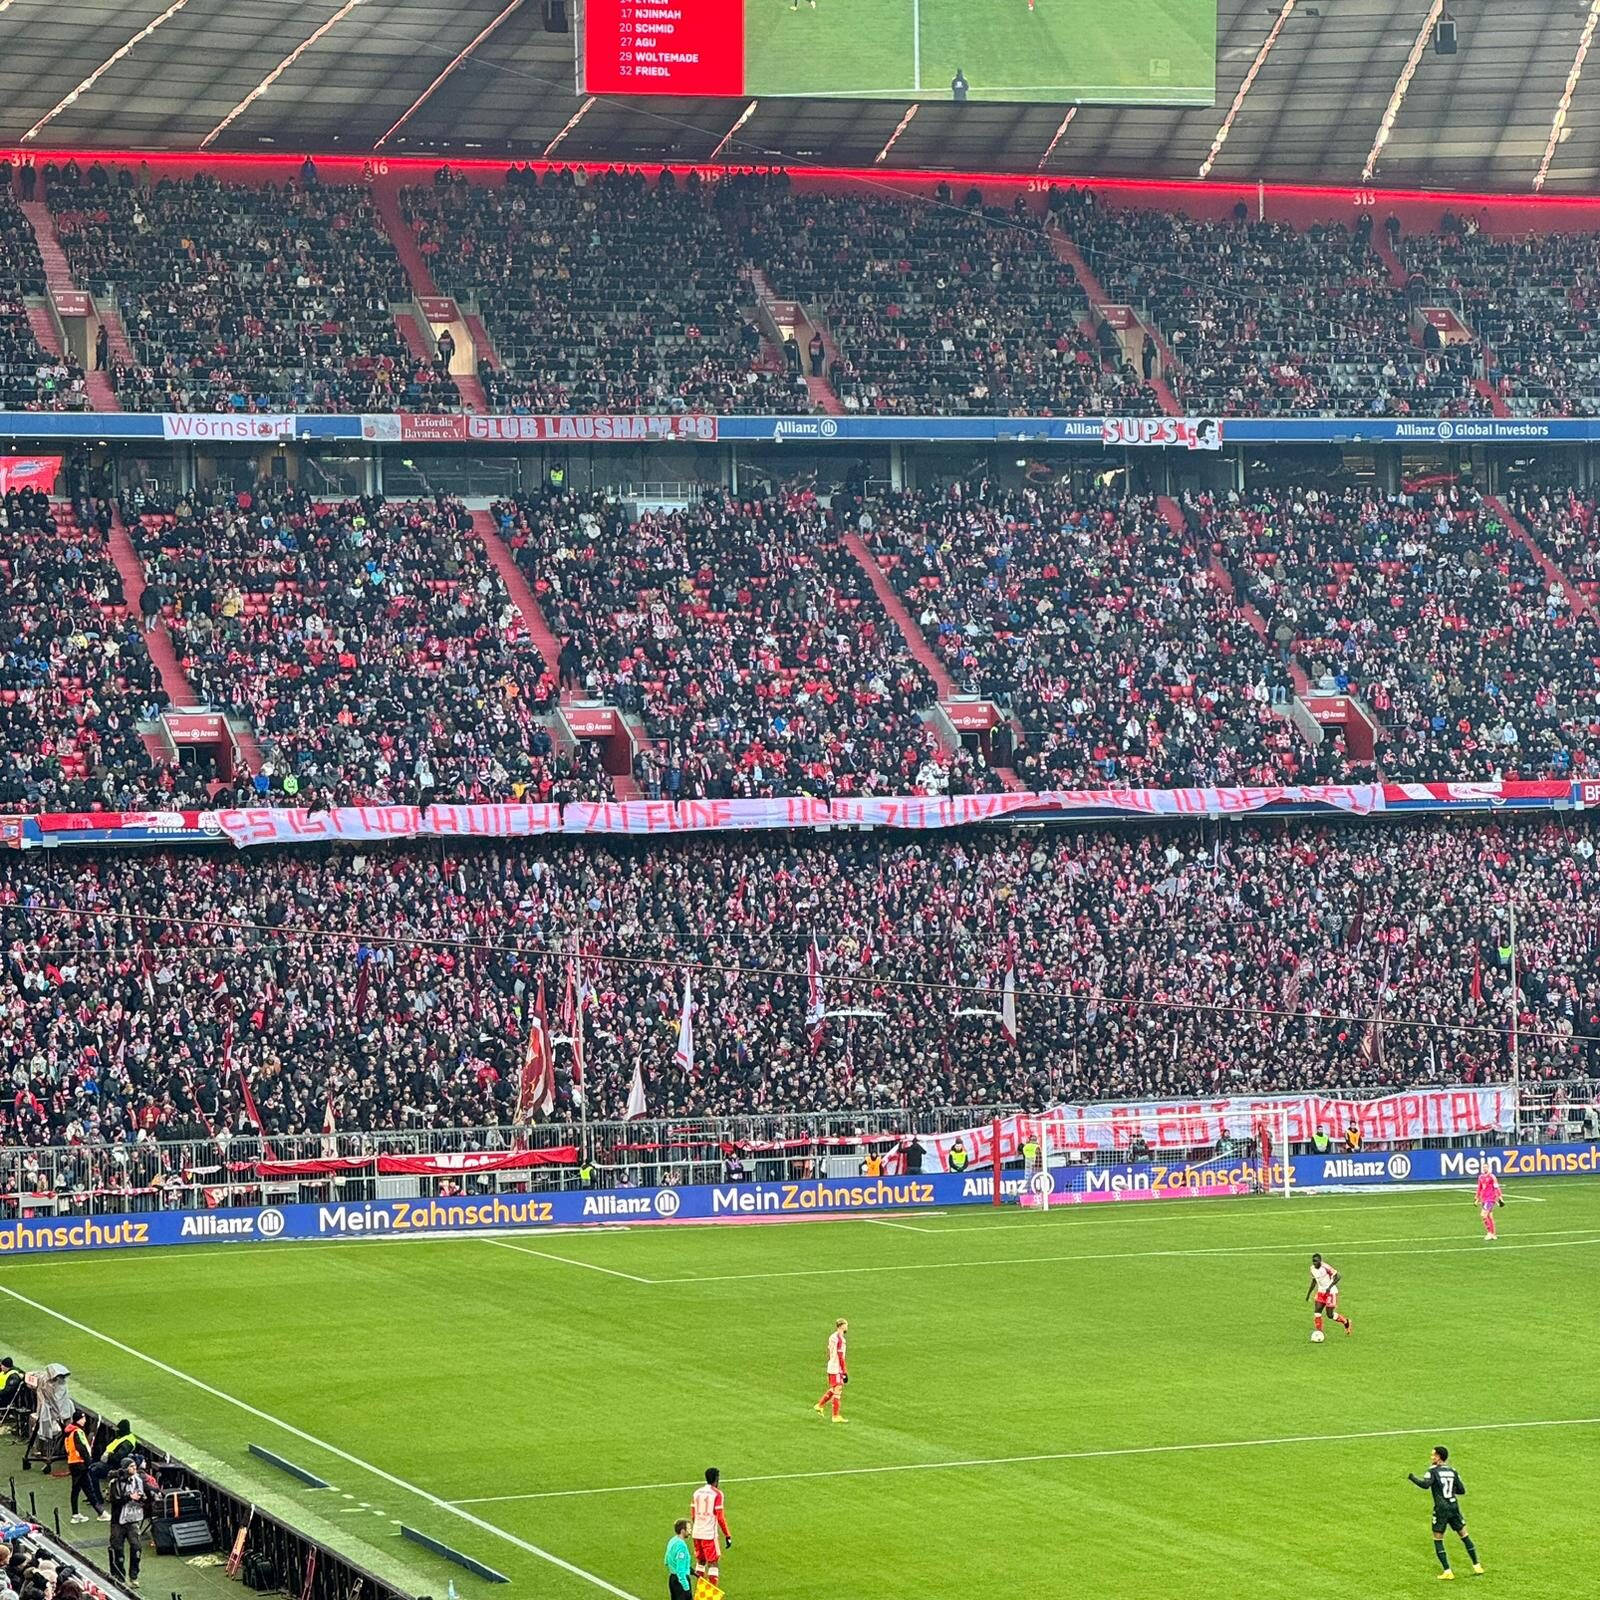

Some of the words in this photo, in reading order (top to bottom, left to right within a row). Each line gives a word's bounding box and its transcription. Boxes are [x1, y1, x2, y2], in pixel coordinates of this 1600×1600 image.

[621, 9, 632, 18] 17
[635, 9, 681, 19] NJINMAH
[619, 23, 632, 32] 20
[635, 24, 674, 33] SCHMID
[620, 37, 632, 46] 27
[635, 38, 656, 47] AGU
[619, 52, 632, 61] 29
[635, 52, 699, 62] WOLTEMADE
[619, 66, 632, 75] 32
[635, 66, 670, 76] FRIEDL
[1353, 191, 1376, 205] 313
[468, 417, 537, 439] CLUB
[774, 420, 817, 434] Allianz
[1103, 418, 1179, 444] SUPS
[1396, 423, 1436, 436] Allianz
[1455, 423, 1493, 436] Global
[1495, 423, 1549, 436] Investors
[1323, 1160, 1384, 1179] Allianz
[583, 1196, 650, 1216] Allianz
[181, 1215, 254, 1236] Allianz
